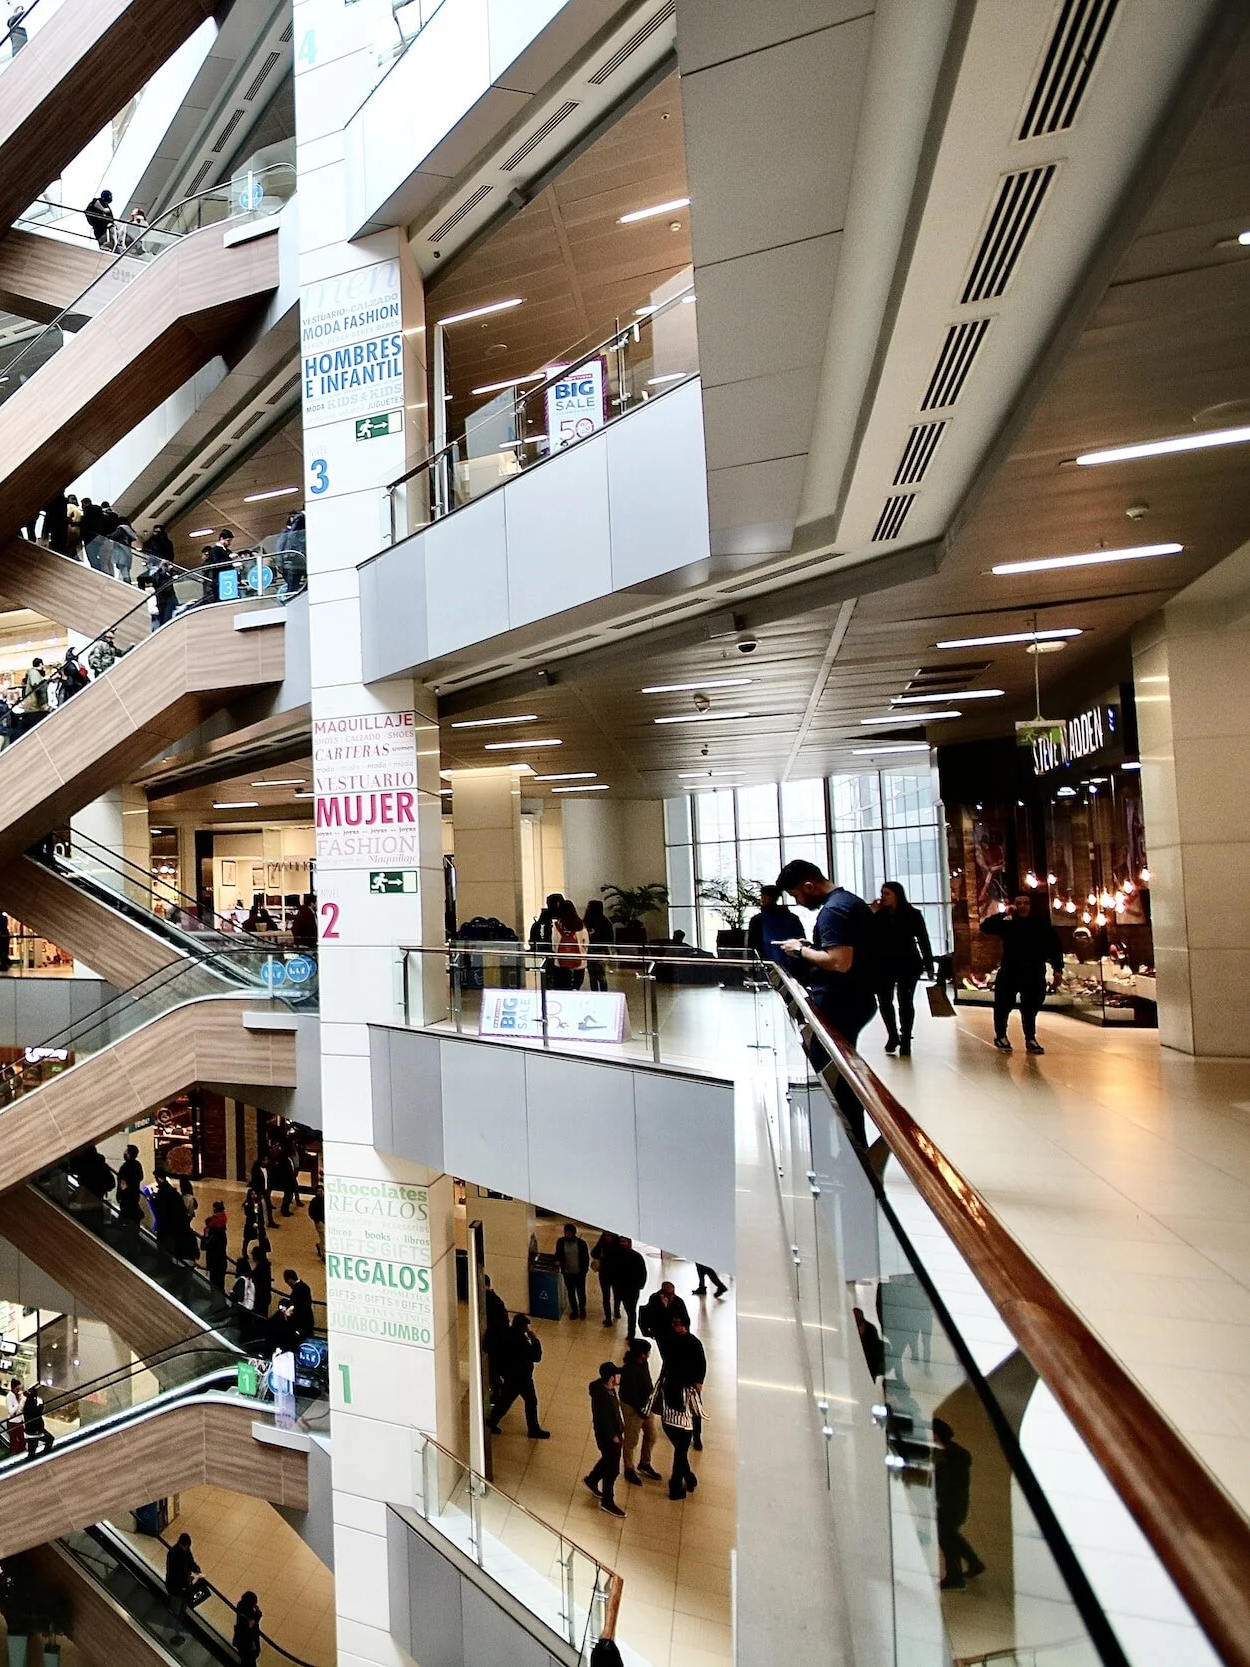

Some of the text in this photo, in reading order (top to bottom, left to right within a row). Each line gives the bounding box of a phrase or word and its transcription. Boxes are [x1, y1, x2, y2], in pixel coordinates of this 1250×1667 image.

[298, 29, 317, 64] 4
[303, 303, 399, 342] MODA FASHION
[305, 334, 402, 379] HOMBRES
[306, 380, 314, 398] E
[321, 357, 403, 395] INFANTIL
[555, 380, 595, 400] BIG
[306, 403, 326, 413] MODA
[328, 394, 359, 411] KIDS
[370, 383, 403, 400] KIDS
[368, 395, 405, 411] JUGUETES
[555, 397, 595, 412] SALE
[310, 458, 329, 494] 3
[223, 580, 232, 596] 3
[314, 713, 413, 735] MAQUILLAJE
[345, 733, 381, 743] CALZADO
[387, 729, 414, 739] SHOES
[315, 742, 390, 762] CARTERAS
[367, 760, 387, 769] moda
[316, 771, 414, 792] VESTUARIO
[316, 791, 415, 828] MUJER
[318, 835, 417, 857] FASHION
[321, 903, 339, 938] 2
[500, 997, 518, 1029] BIG
[518, 997, 530, 1030] SALE
[326, 1178, 428, 1202] chocolates
[329, 1194, 429, 1221] REGALOS
[329, 1227, 430, 1246] libros books libros
[330, 1237, 430, 1262] GIFTS GIFTS
[328, 1254, 430, 1293] REGALOS
[329, 1288, 431, 1313] GIFTS GIFTS GIFTS
[330, 1312, 432, 1344] JUMBO JUMBO
[242, 1374, 250, 1391] 1
[338, 1364, 352, 1404] 1
